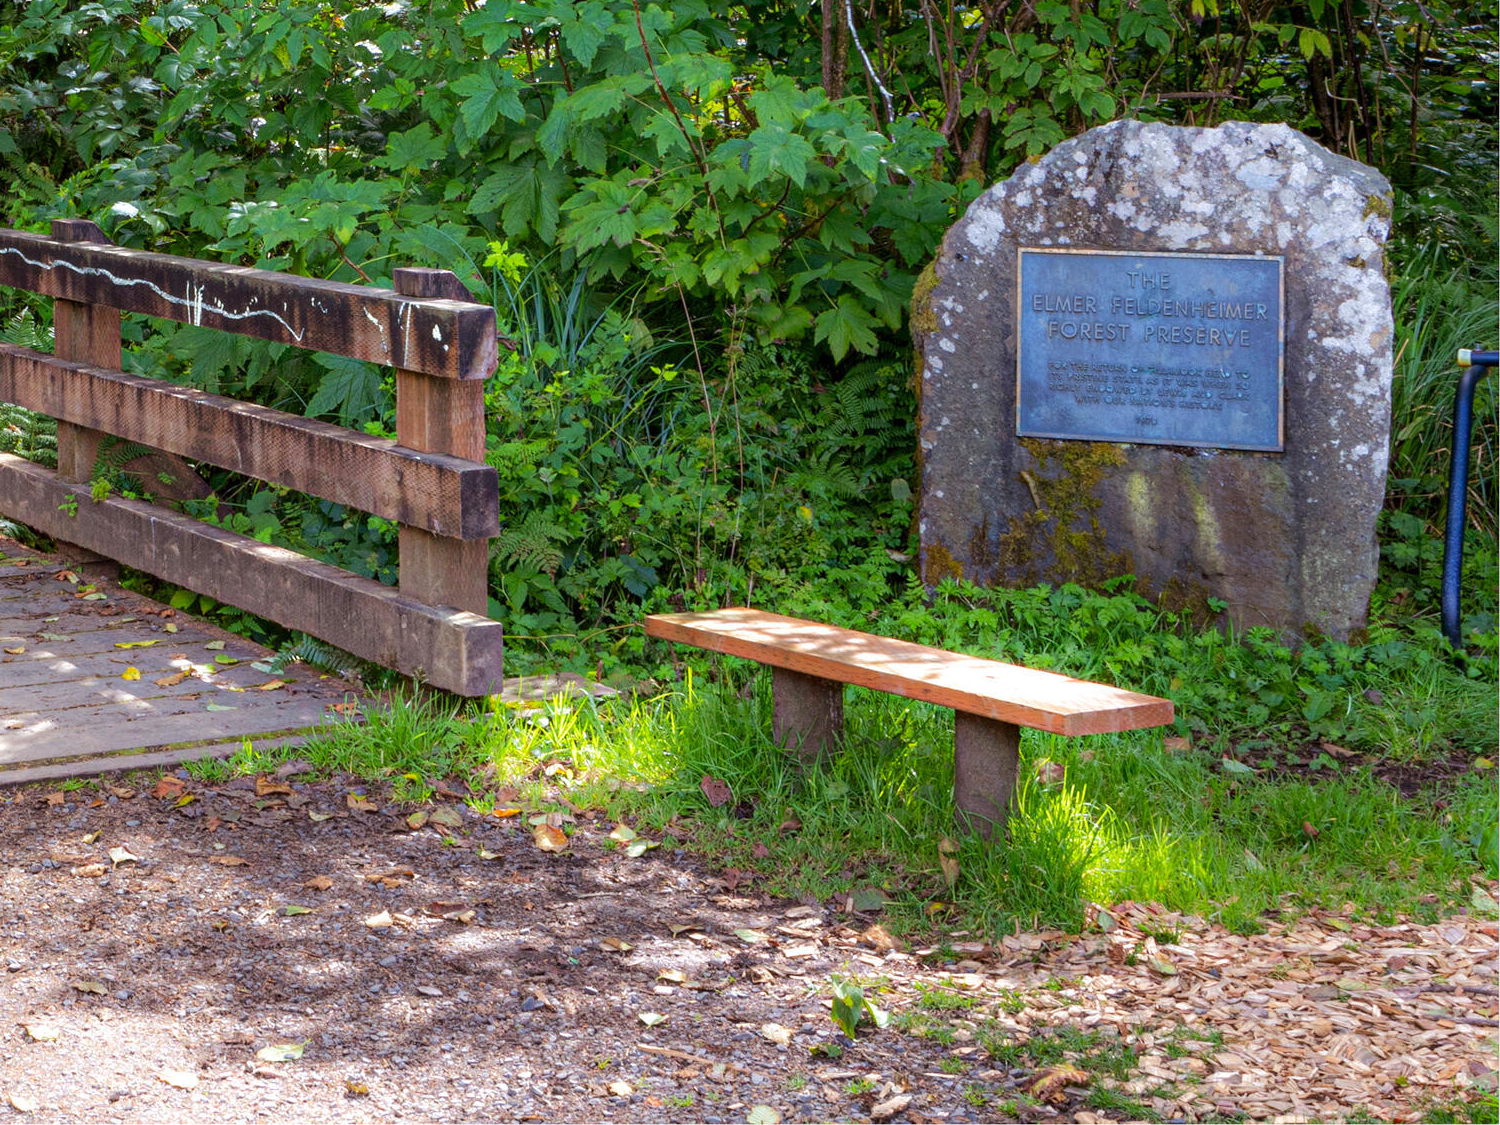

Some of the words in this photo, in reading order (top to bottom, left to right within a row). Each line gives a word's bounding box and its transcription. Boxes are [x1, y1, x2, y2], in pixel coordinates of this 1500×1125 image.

[1127, 270, 1171, 291] THE
[1032, 294, 1097, 314] ELMER
[1111, 296, 1269, 321] FELDENHEIMER
[1047, 321, 1130, 342] FOREST
[1144, 326, 1251, 347] PRESERVE
